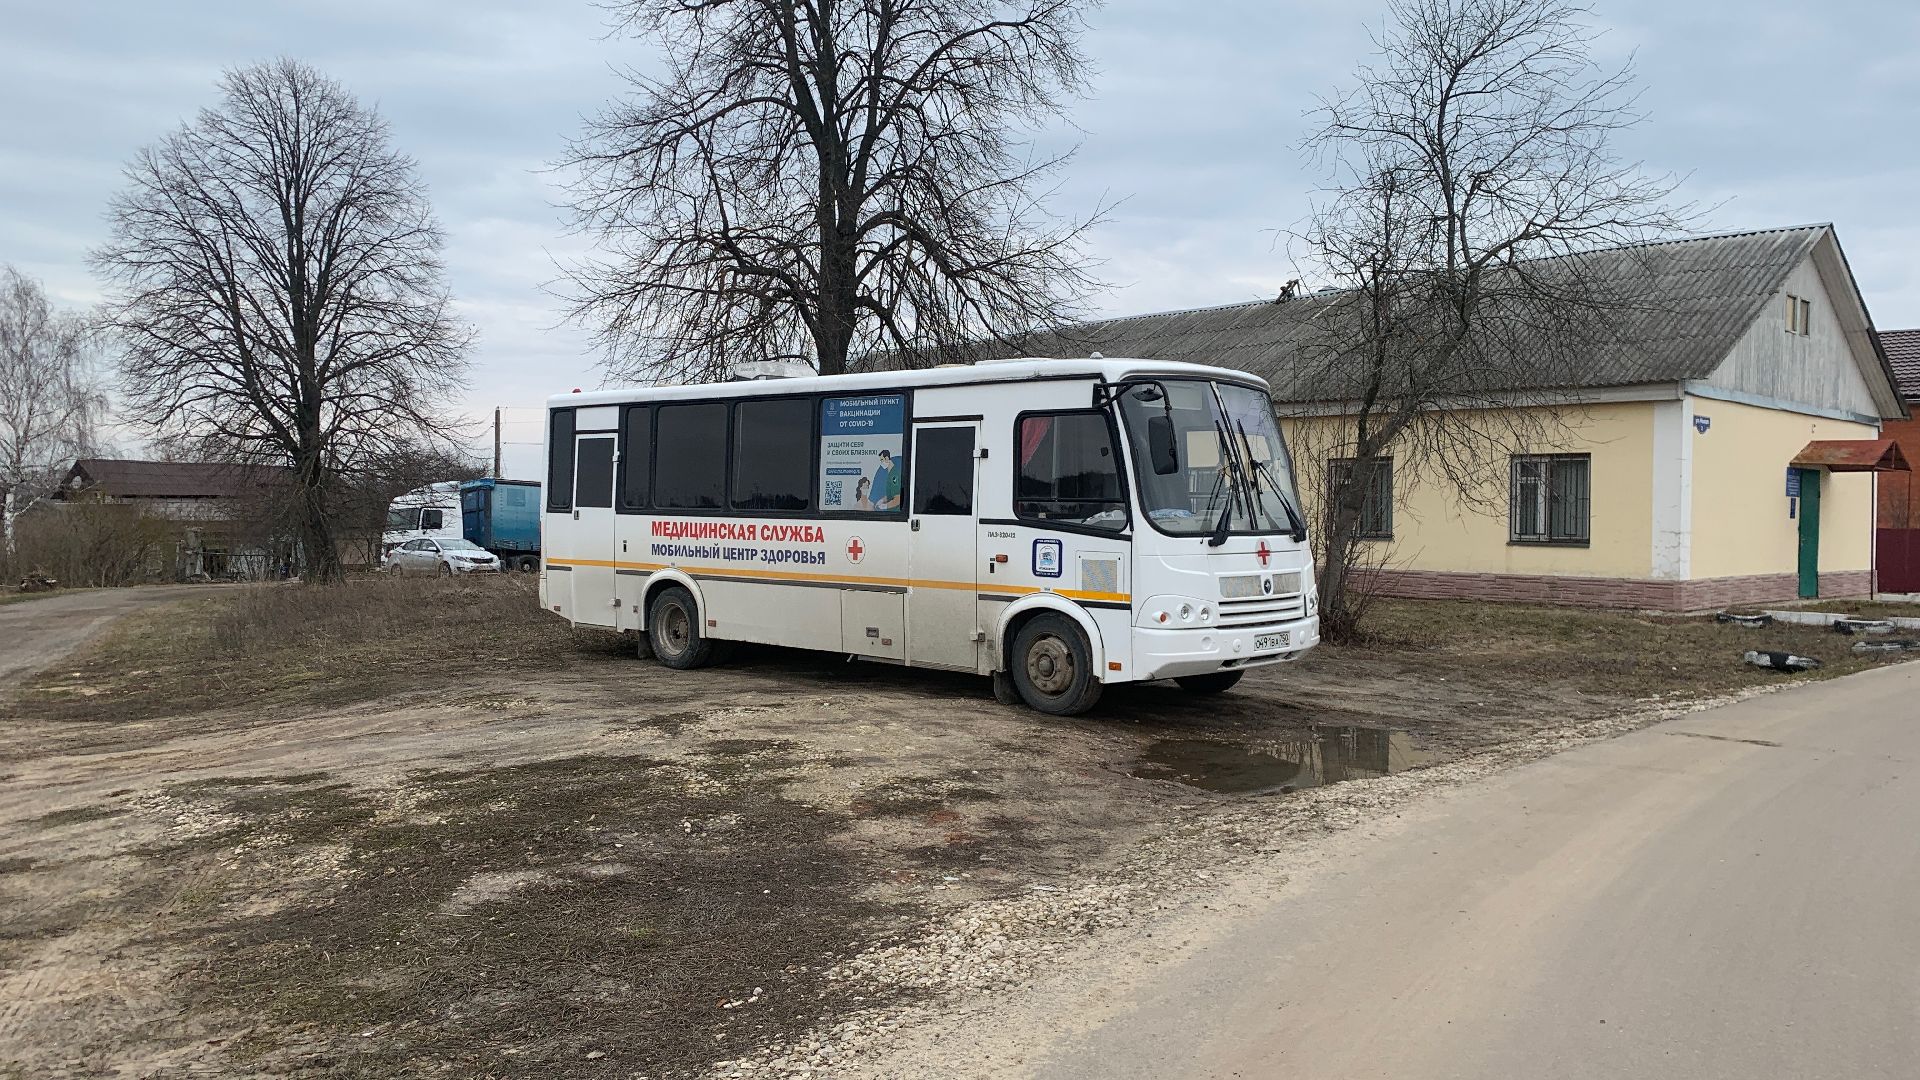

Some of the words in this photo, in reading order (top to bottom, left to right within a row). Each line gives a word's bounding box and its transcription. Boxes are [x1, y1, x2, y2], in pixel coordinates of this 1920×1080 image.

[840, 398, 878, 407] МОБИЛЬНЫЙ
[840, 409, 880, 417] ВАКЦИНАЦИИ
[651, 521, 756, 541] МЕДИЦИНСКАЯ
[760, 524, 825, 543] СЛУЖБА
[651, 543, 720, 559] МОБИЛЬНЫЙ
[722, 548, 757, 562] ЦЕНТР
[760, 550, 825, 565] ЗДОРОВЬЯ
